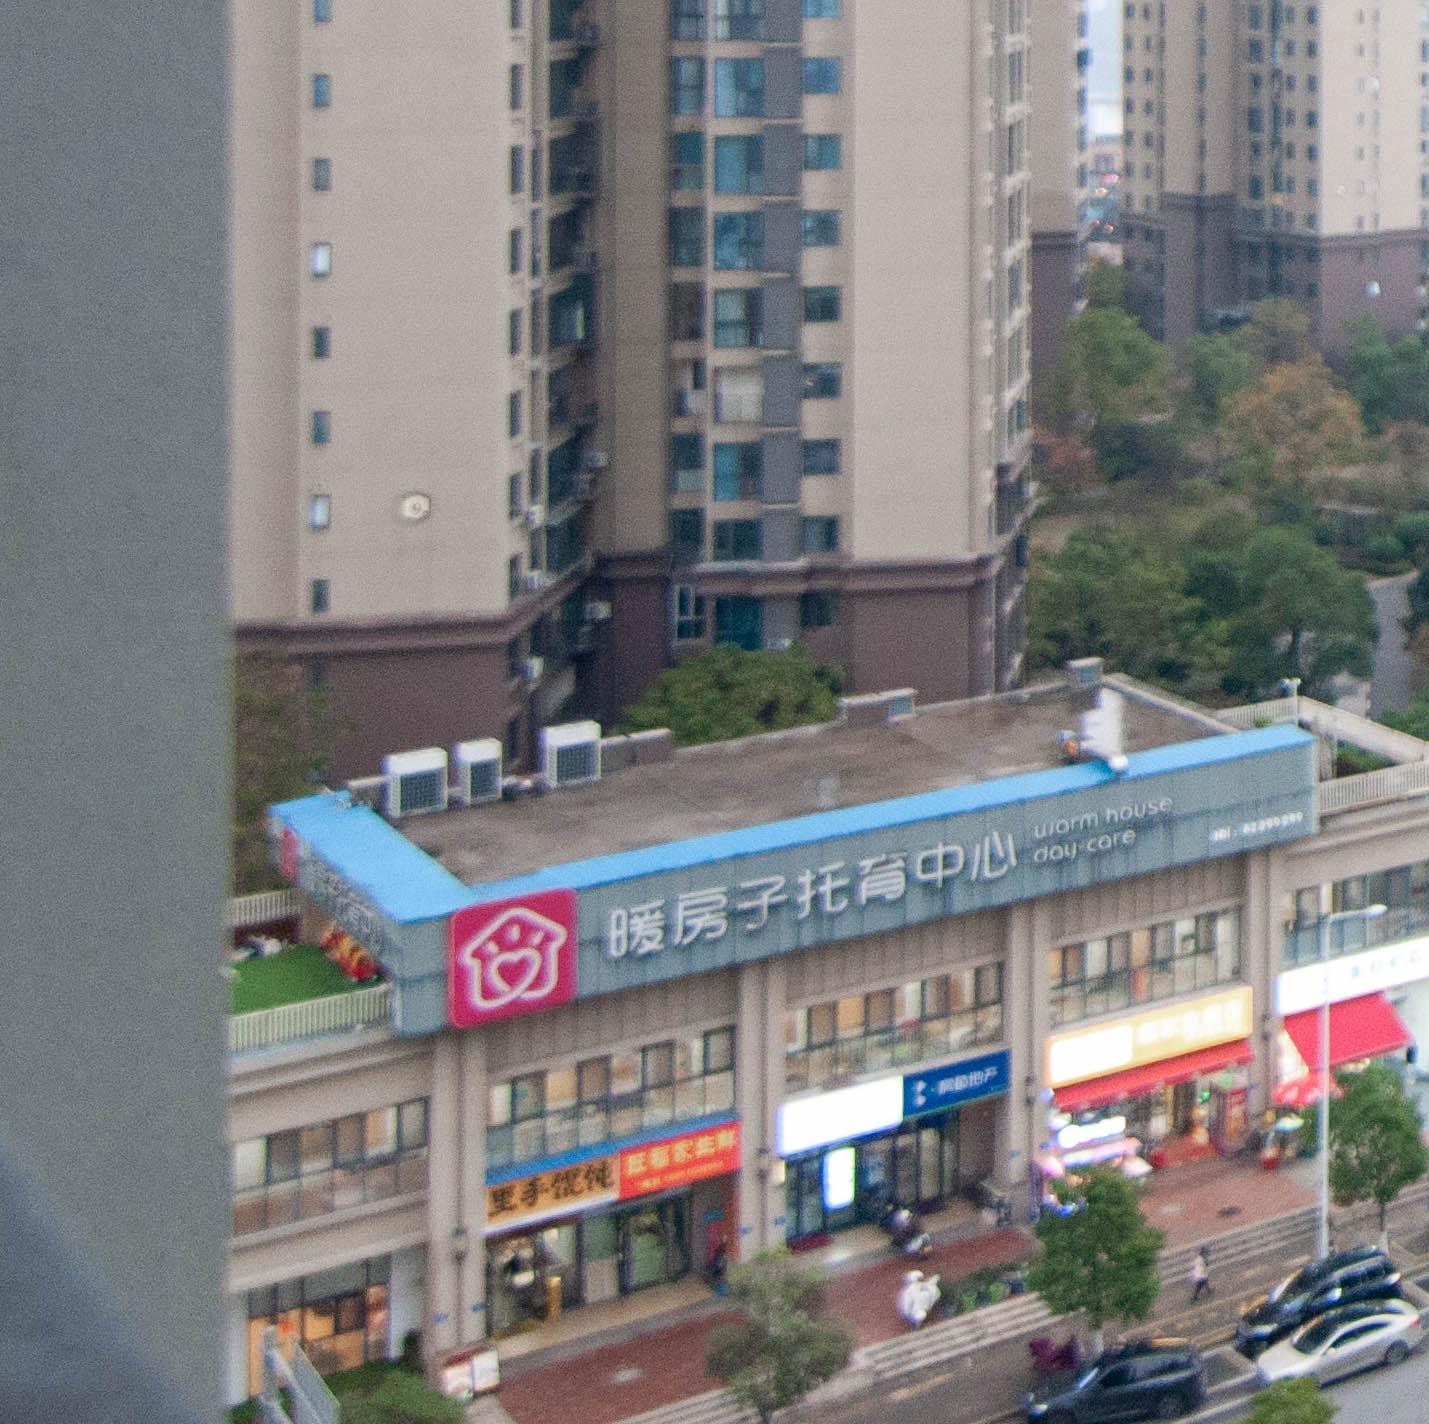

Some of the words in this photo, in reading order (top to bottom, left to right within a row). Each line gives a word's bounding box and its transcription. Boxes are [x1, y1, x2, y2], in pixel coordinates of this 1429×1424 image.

[1034, 812, 1099, 839] warm
[1106, 798, 1173, 825] house
[606, 830, 1018, 959] 暖房子托育中心
